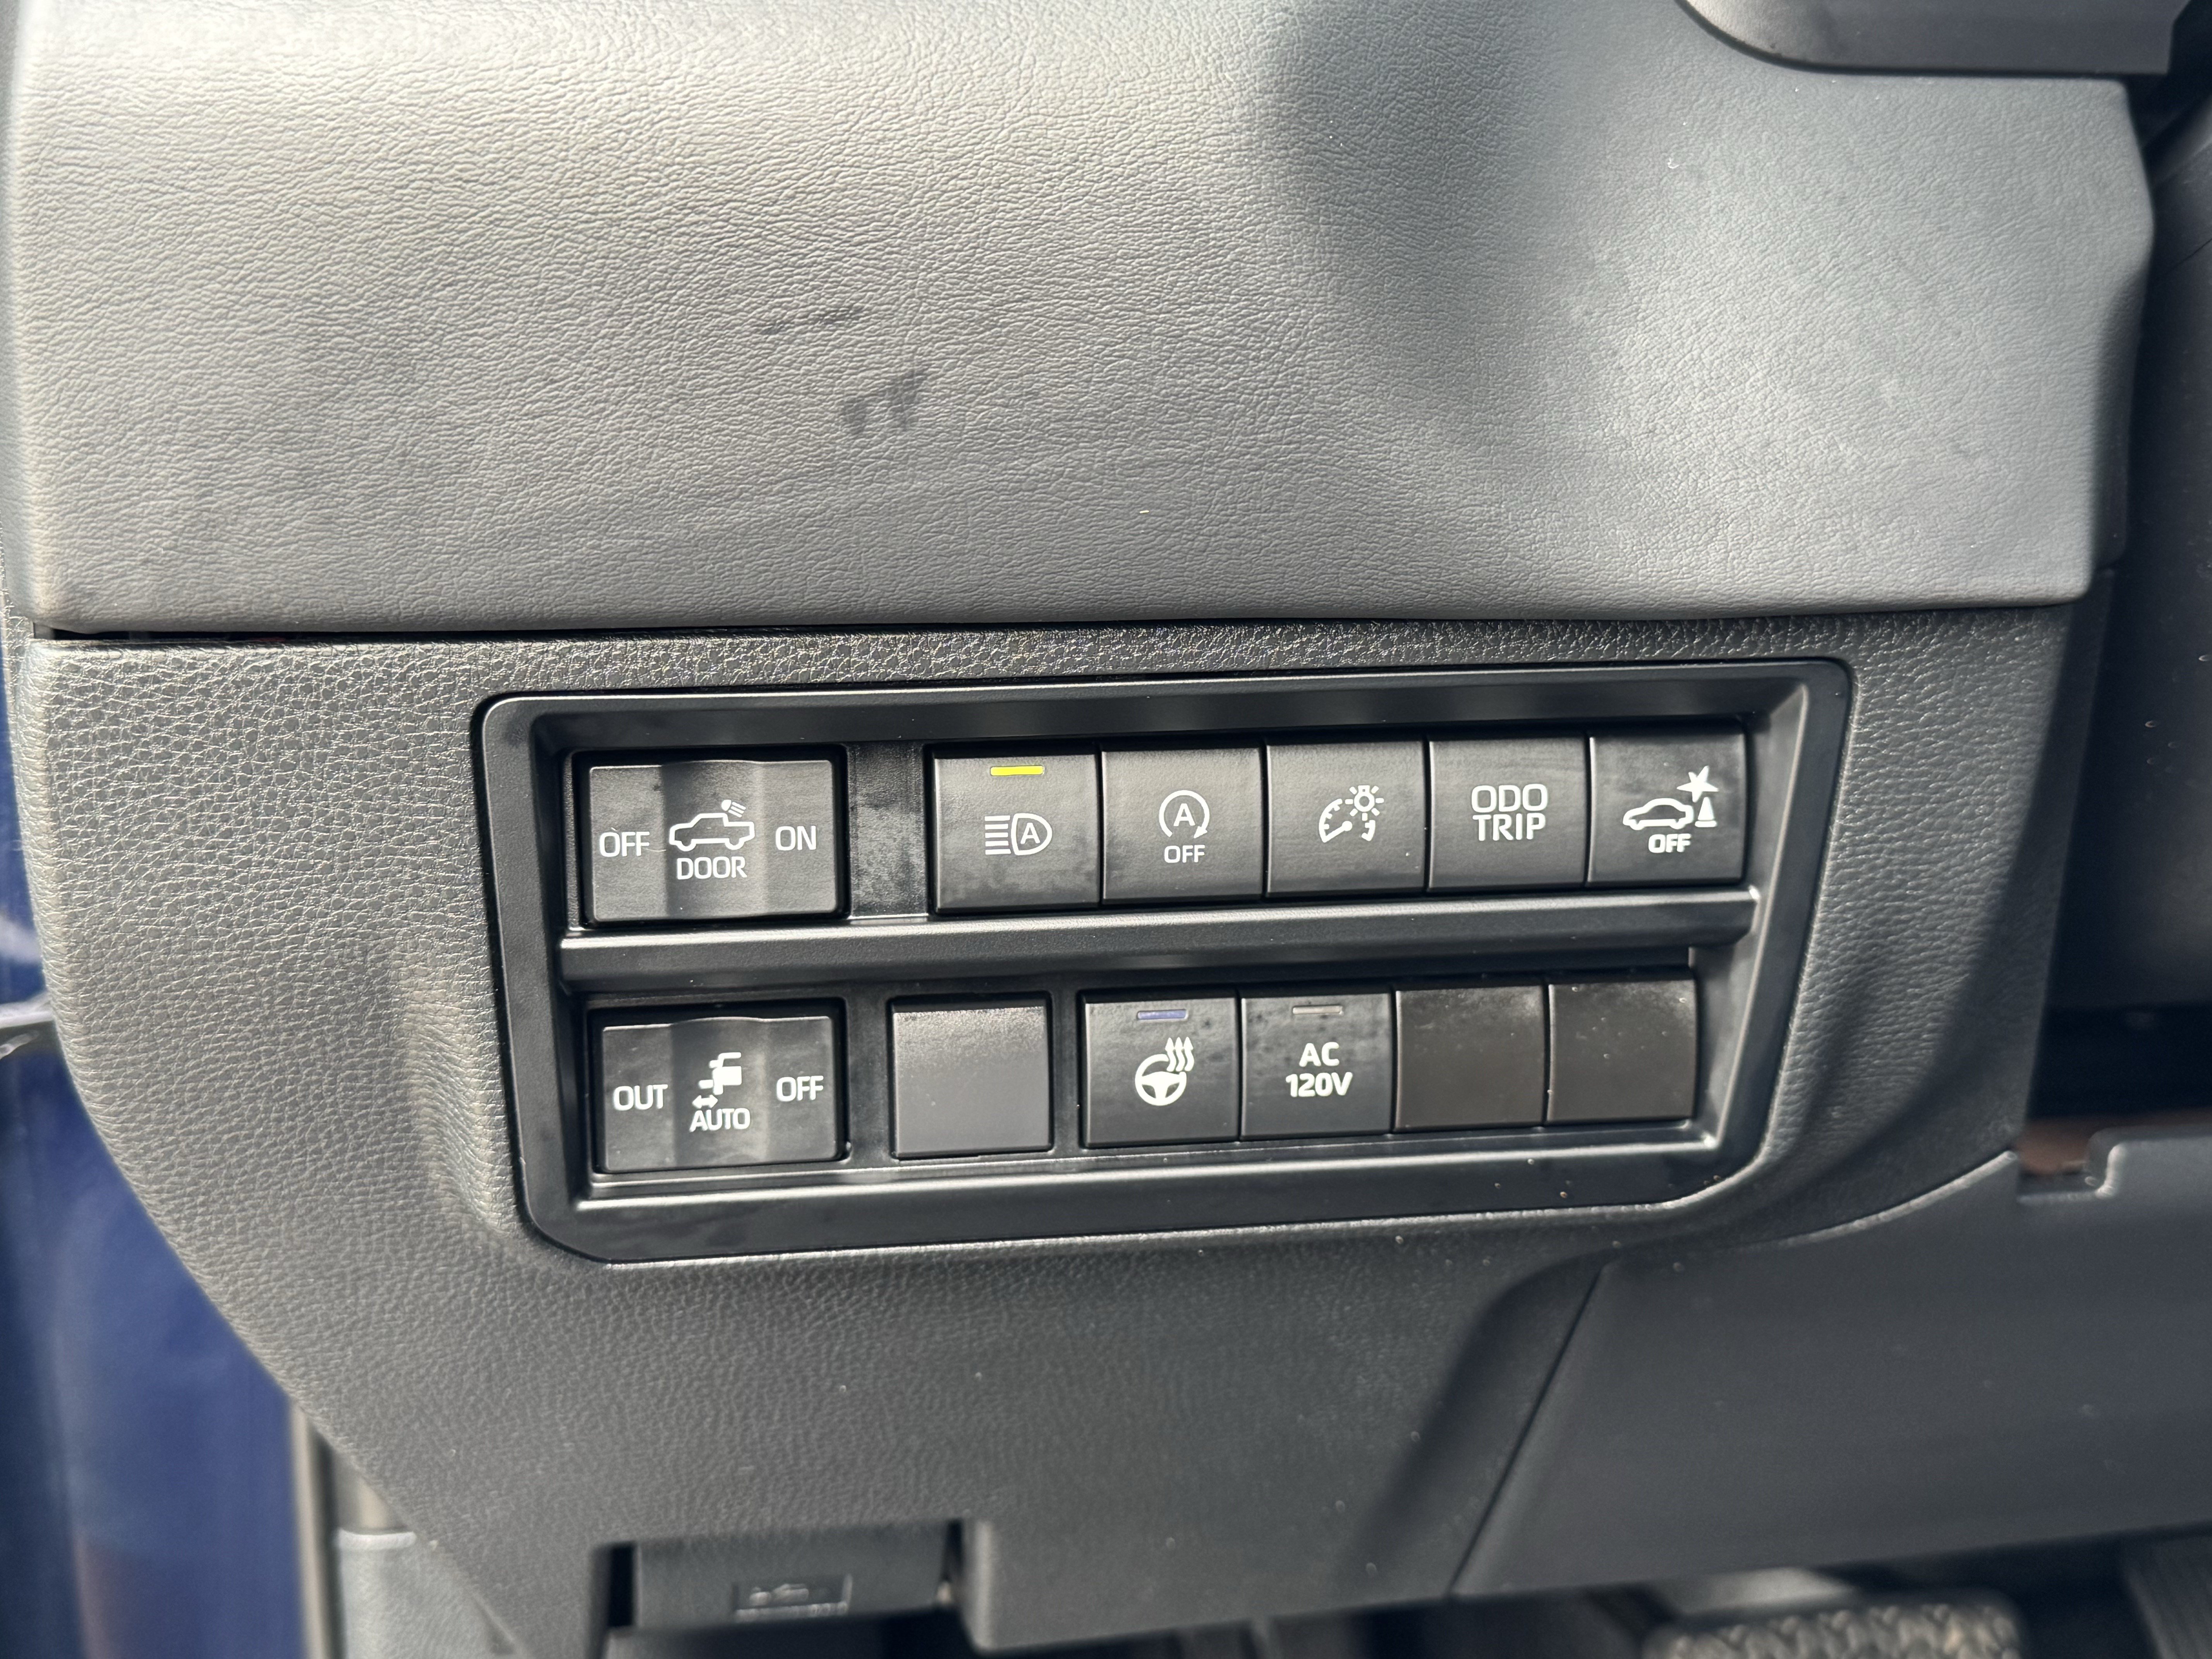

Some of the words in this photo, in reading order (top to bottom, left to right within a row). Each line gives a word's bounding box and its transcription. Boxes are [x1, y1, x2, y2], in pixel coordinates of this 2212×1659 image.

[1471, 784, 1548, 813] ODO
[1173, 803, 1195, 827] A
[1472, 812, 1546, 841] TRIP
[599, 831, 650, 857] OFF
[776, 825, 816, 851] ON
[1020, 822, 1041, 844] A
[1648, 833, 1692, 853] OFF
[1164, 844, 1205, 863] OFF
[677, 856, 747, 880] DOOR
[1299, 1042, 1340, 1067] AC
[776, 1075, 824, 1102] OFF
[1285, 1072, 1353, 1097] 120V
[613, 1084, 668, 1111] OUT
[689, 1108, 750, 1132] AUTO
